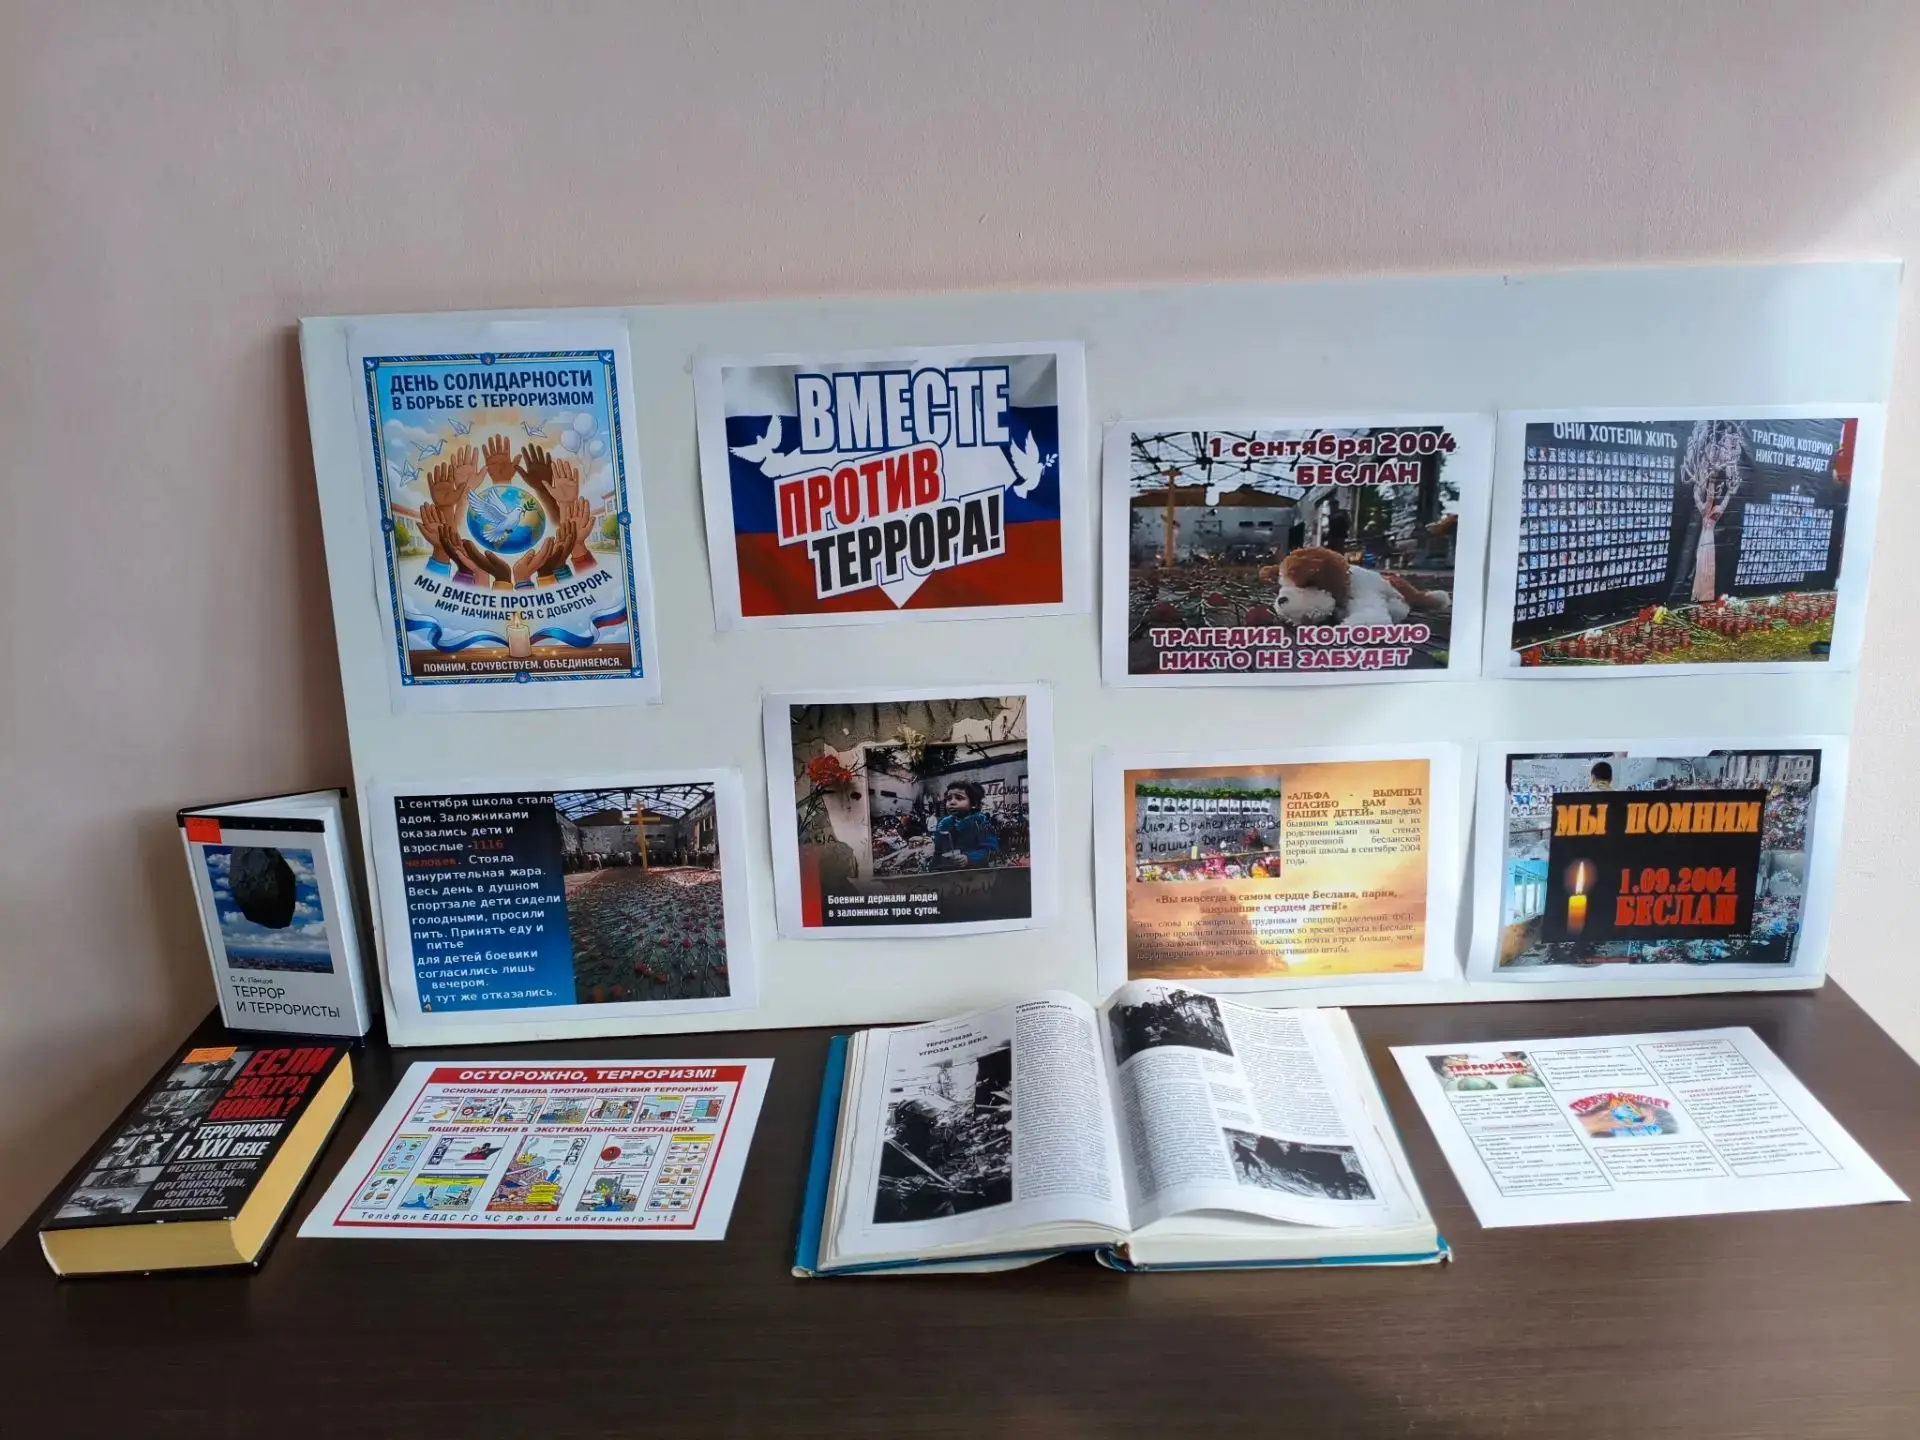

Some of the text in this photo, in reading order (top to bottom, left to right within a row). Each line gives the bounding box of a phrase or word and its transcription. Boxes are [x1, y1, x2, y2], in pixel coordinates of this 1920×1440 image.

[390, 369, 594, 395] ДЕНЬ СОЛИДАРНОСТИ
[391, 391, 595, 410] В БОРЬБЕ С ТЕРРОРИЗМОМ
[796, 367, 1010, 453] ВМЕСТЕ
[1553, 422, 1678, 449] ОНИ ХОТЕЛИ ЖИТЬ
[1752, 429, 1834, 456] ТРАГЕДИЯ, КОТОРУЮ
[1209, 431, 1457, 461] 1 сентября 2004
[1756, 448, 1830, 473] НИКТО НЕ ЗАБУДЕТ
[1296, 463, 1421, 487] БЕСЛАН
[778, 448, 941, 540] ПРОТИВ
[812, 494, 1001, 593] ТЕРРОРА!
[413, 569, 613, 610] МЫ ВМЕСТЕ ПРОТИВ ТЕРРОРА
[434, 599, 460, 615] МИР
[536, 608, 545, 620] С
[547, 595, 597, 619] ДОБРОТЫ
[1150, 625, 1430, 649] ТРАГЕДИЯ, КОТОРУЮ
[422, 656, 623, 674] ПОМНИМ. СОЧУВСТВУЕМ. ОБЪЕДИНЯЕМСЯ.
[1160, 648, 1413, 670] НИКТО НЕ ЗАБУДЕТ
[1287, 791, 1330, 801] «АЛЬФА
[1373, 788, 1422, 798] ВЫМПЕЛ
[398, 795, 554, 811] 1 сентября школа стала
[1287, 798, 1422, 810] СПАСИБО ВАМ ЗА
[399, 811, 529, 826] адом. Заложниками
[1286, 810, 1329, 819] НАШИХ
[1333, 807, 1375, 819] ДЕТЕЙ»
[1554, 801, 1763, 836] МЫ ПОМНИМ
[401, 826, 514, 839] оказались дети и
[403, 841, 464, 854] взрослые
[468, 854, 514, 865] Стояла
[406, 867, 547, 883] изнурительная жара.
[1620, 868, 1738, 894] 1.09.2004
[408, 882, 539, 897] Весь день в душном
[1155, 894, 1178, 904] «Вы
[1238, 893, 1272, 901] самом
[1274, 891, 1310, 902] сердце
[410, 894, 561, 912] спортзале дети сидели
[827, 892, 939, 906] Боевики держали людей
[828, 906, 941, 918] в заложниках трое суток.
[1263, 903, 1306, 914] сердцем
[1614, 894, 1738, 926] БЕСЛАН
[412, 910, 545, 926] голодными, просили
[413, 924, 544, 940] пить. Принять еду и
[426, 939, 465, 951] питье
[417, 949, 538, 967] для детей боевики
[418, 964, 536, 979] согласились лишь
[232, 985, 286, 1000] ТЕРРОР
[431, 979, 489, 991] вечером.
[422, 988, 558, 1005] И тут же отказались.
[236, 1001, 341, 1019] И ТЕРРОРИСТЫ
[918, 1046, 950, 1057] УГРОЗА
[968, 1035, 989, 1046] ВЕКА
[926, 1032, 973, 1048] ТЕРРОРИЗМ
[240, 1047, 337, 1078] ЕСЛИ
[458, 1068, 717, 1082] ОСТОРОЖНО, ТЕРРОРИЗМ!
[224, 1075, 312, 1098] ЗАВТРА
[550, 1086, 652, 1094] ПРОТИВОДЕЙСТВИЯ
[207, 1094, 301, 1121] ВОЙНА?
[193, 1122, 283, 1140] ТЕРРОРИЗМ
[461, 1125, 519, 1134] ДЕЙСТВИЯ
[192, 1137, 234, 1159] XXI
[228, 1141, 271, 1157] ВЕКЕ
[166, 1161, 258, 1174] ИСТОКИ, ЦЕЛИ,
[176, 1170, 235, 1181] МЕТОДЫ,
[153, 1178, 248, 1191] ОРГАНИЗАЦИИ,
[164, 1188, 224, 1198] ФИГУРЫ,
[153, 1196, 227, 1208] ПРОГНОЗЫ
[361, 1212, 417, 1221] Телефон
[422, 1213, 457, 1222] ЕДДС
[484, 1214, 501, 1222] ЧС
